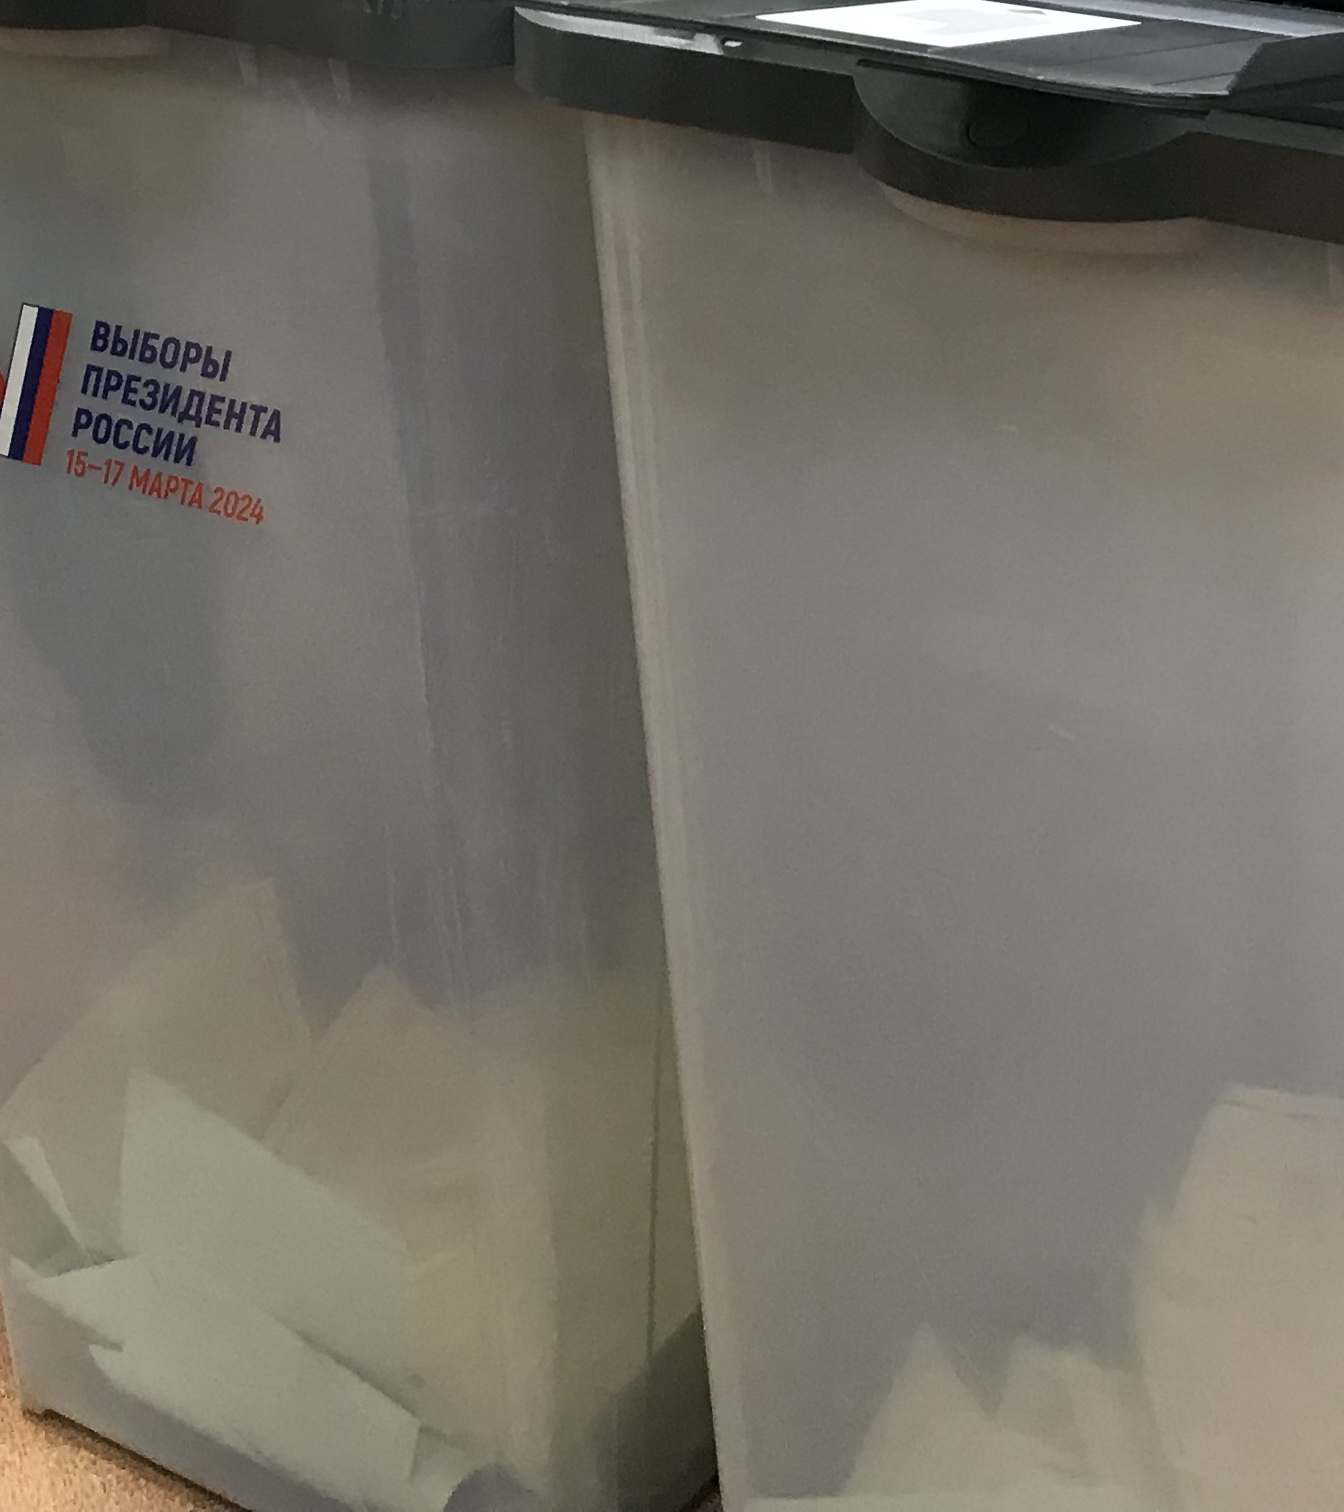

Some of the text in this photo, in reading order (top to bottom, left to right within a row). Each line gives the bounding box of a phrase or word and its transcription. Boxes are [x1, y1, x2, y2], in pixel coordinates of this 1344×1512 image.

[89, 319, 234, 383] ВЫБОРЫ
[80, 364, 283, 444] ПРЕЗИДЕНТА
[72, 407, 199, 468] РОССИИ
[128, 464, 205, 510] МАРТА
[208, 486, 265, 526] 2024
